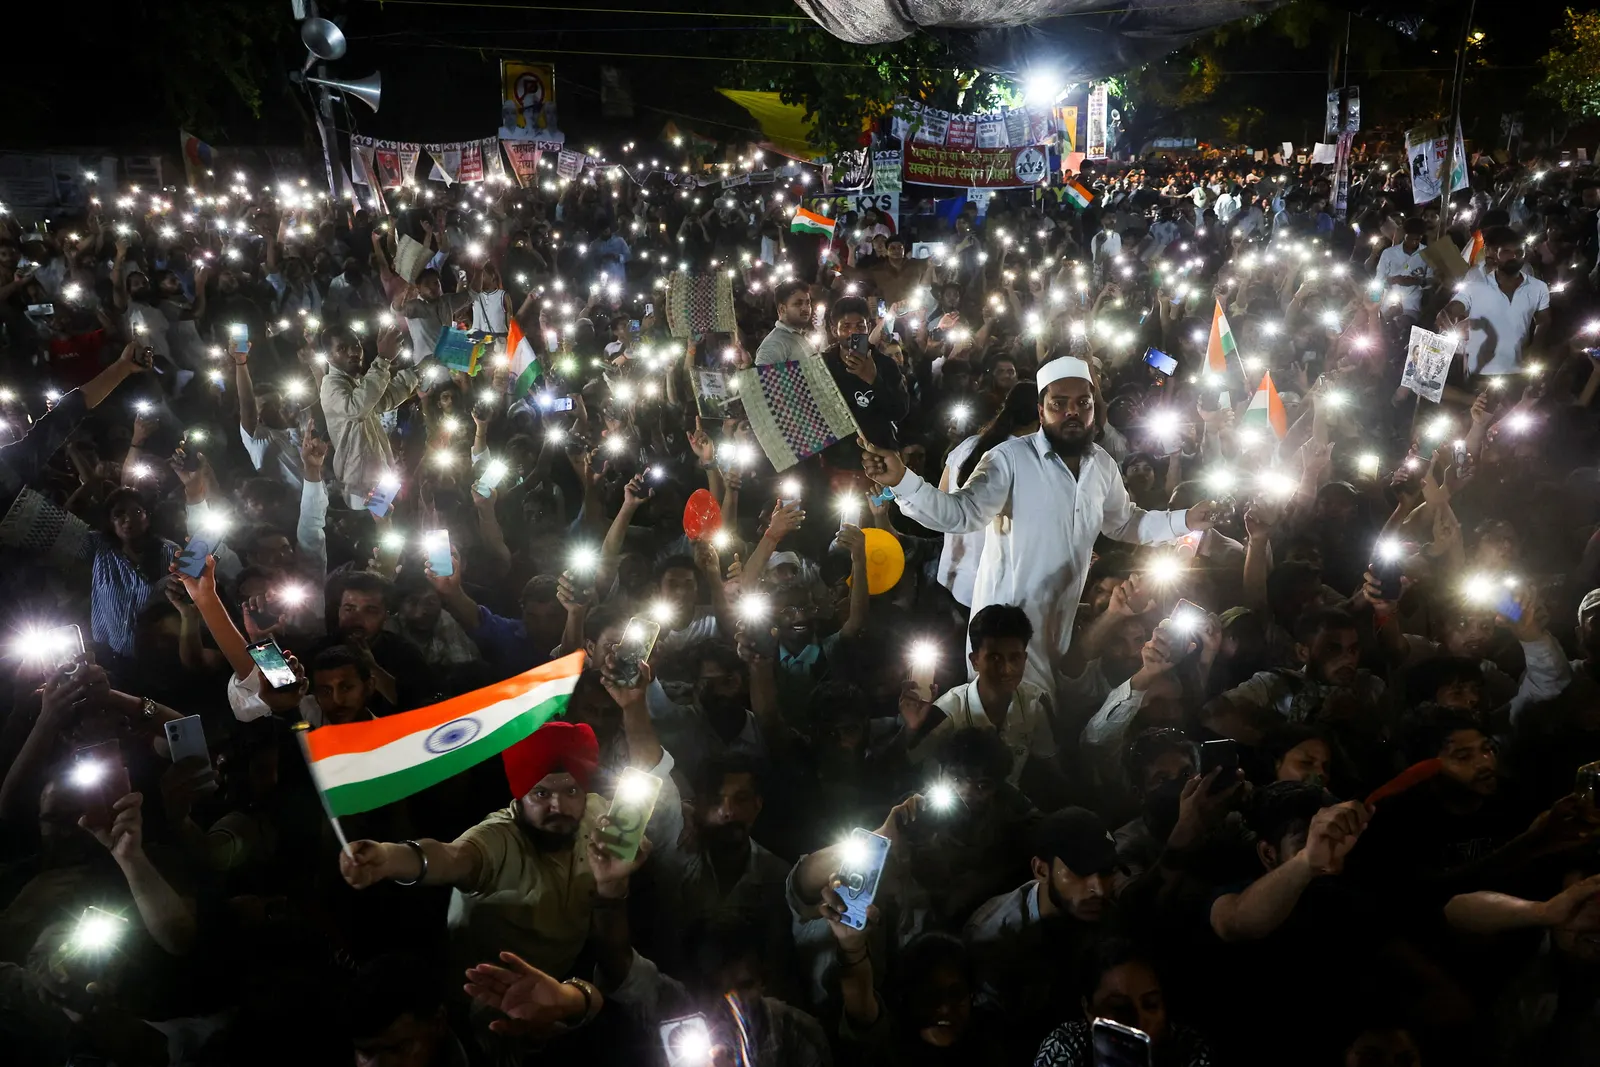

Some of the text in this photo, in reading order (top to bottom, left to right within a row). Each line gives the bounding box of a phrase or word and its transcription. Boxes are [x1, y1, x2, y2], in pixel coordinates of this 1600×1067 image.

[924, 105, 949, 119] KYS
[951, 113, 975, 122] KYS
[978, 113, 1003, 122] KYS
[351, 133, 373, 146] KYS
[376, 139, 397, 150] KYS
[401, 142, 420, 151] KYS
[443, 142, 461, 151] KYS
[539, 142, 561, 151] KYS
[874, 149, 899, 159] KYS
[1089, 146, 1105, 155] KYS
[908, 161, 937, 178] सबको
[856, 195, 892, 213] KYS
